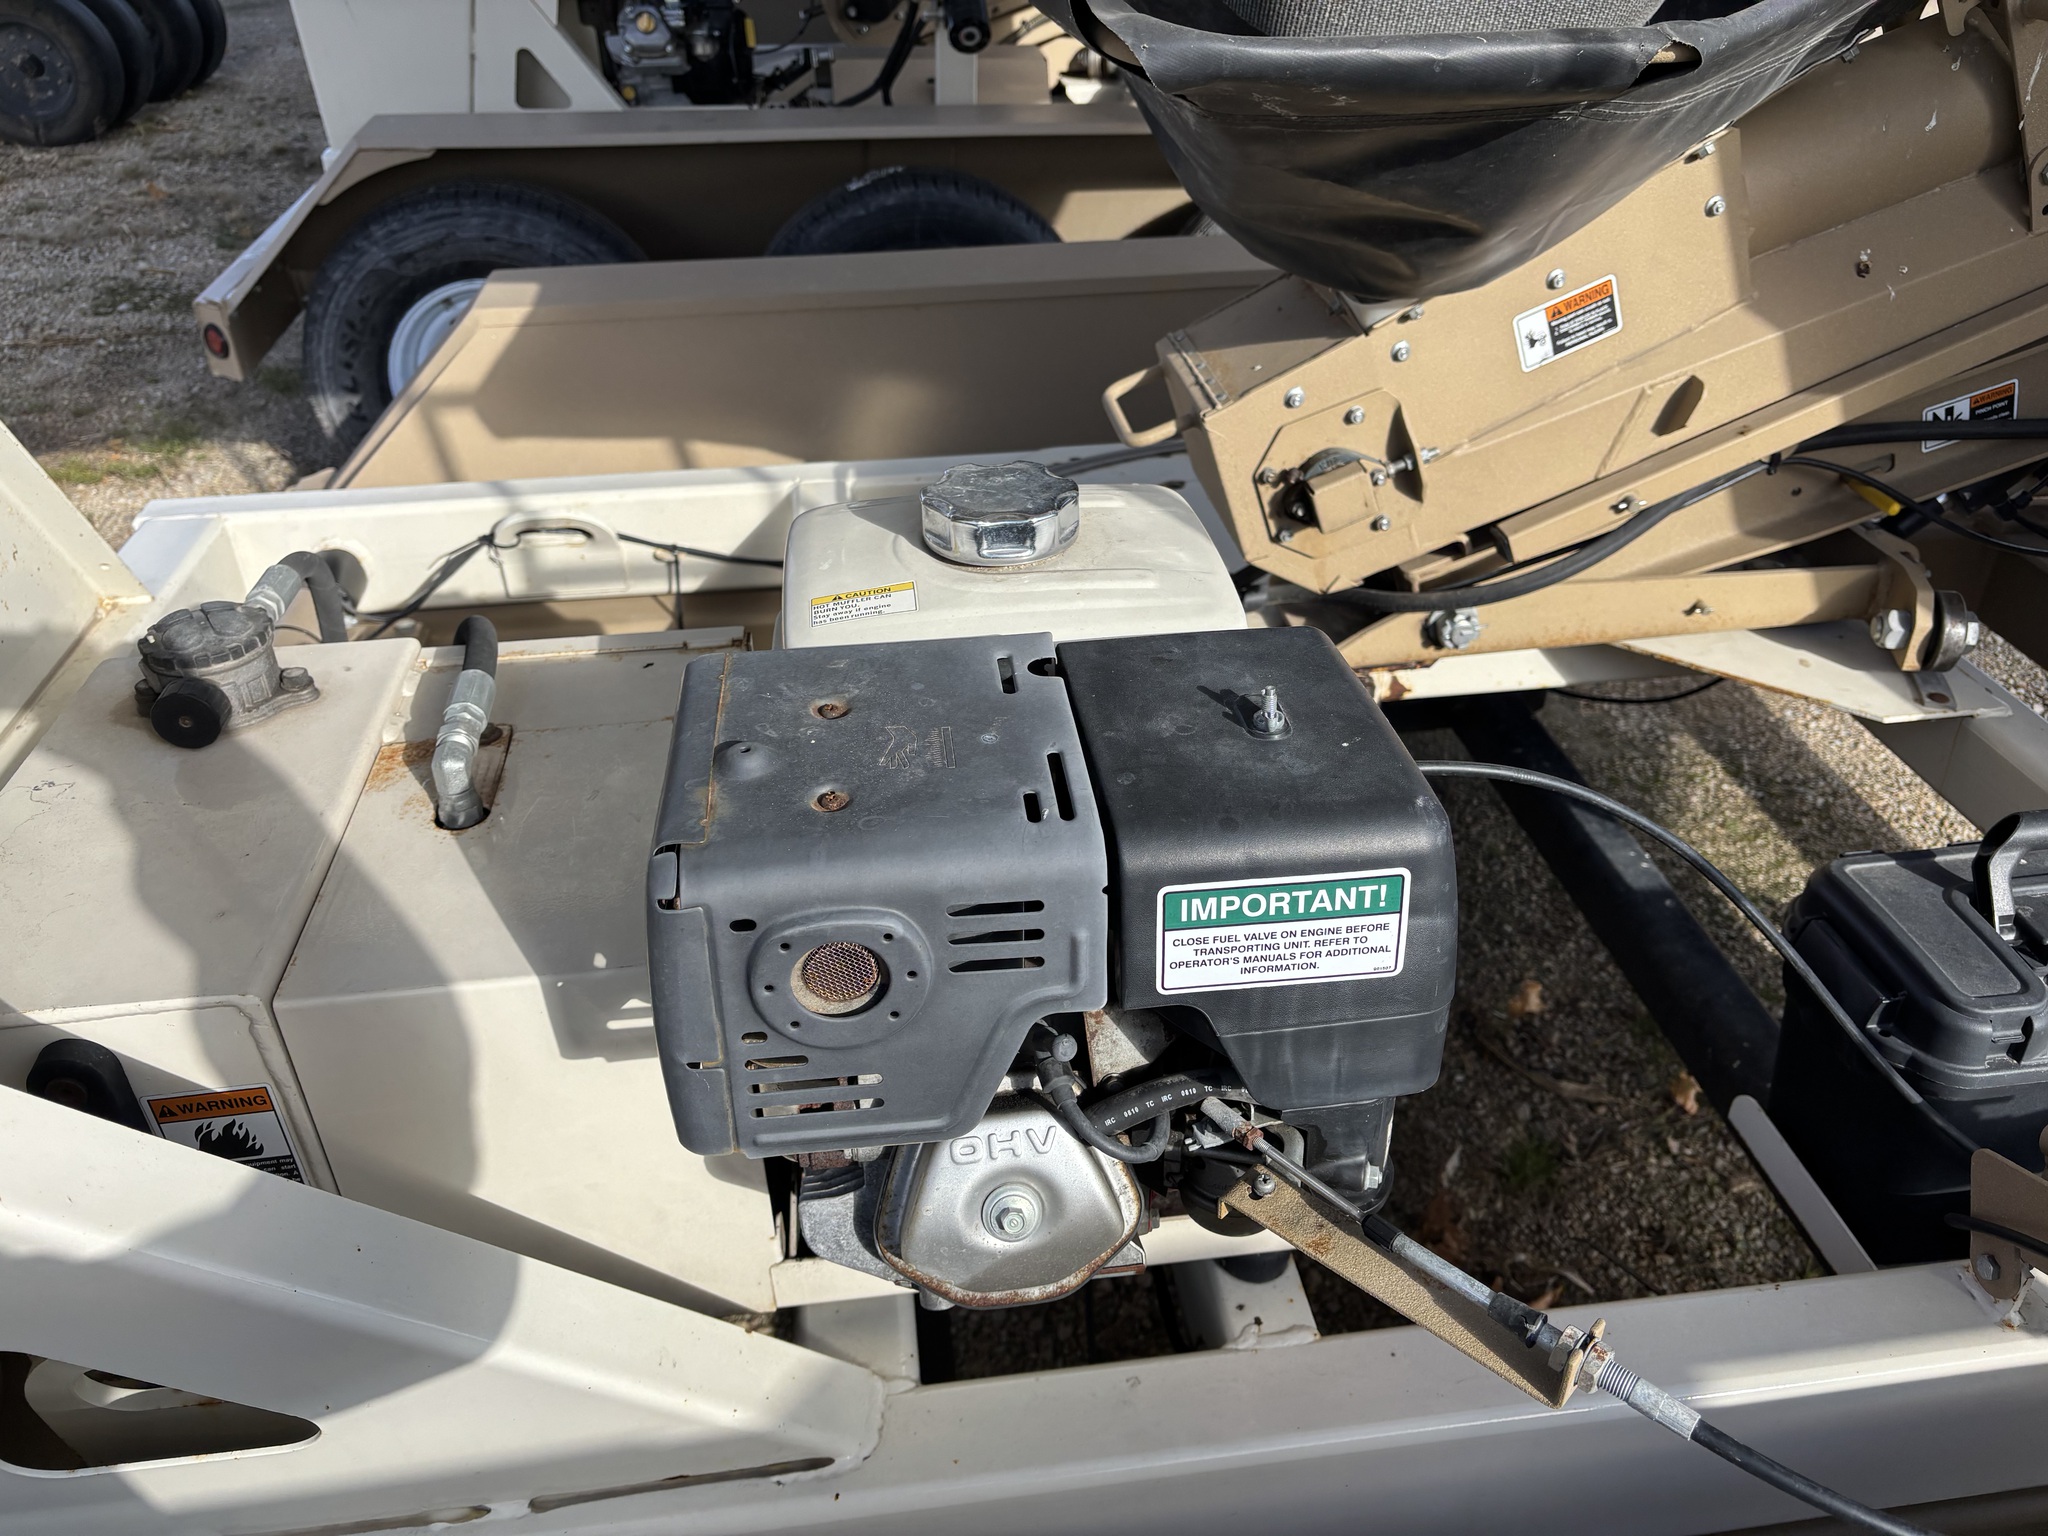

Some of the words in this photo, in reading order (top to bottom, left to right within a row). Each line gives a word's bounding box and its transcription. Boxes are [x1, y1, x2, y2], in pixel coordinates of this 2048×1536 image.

[1563, 284, 1609, 312] WARNING
[1979, 386, 2013, 404] WARNING
[1992, 400, 2009, 410] POINT
[813, 603, 829, 611] HOT
[833, 596, 871, 606] MUFFLER
[874, 593, 892, 601] CAN
[845, 587, 891, 598] CAUTION
[813, 607, 838, 615] BURN
[813, 613, 830, 621] Stay
[833, 609, 853, 617] away
[863, 603, 891, 612] engine
[1181, 884, 1387, 922] IMPORTANT!
[1172, 936, 1210, 947] CLOSE
[1213, 935, 1241, 944] FUEL
[1244, 931, 1278, 942] VALVE
[1280, 930, 1297, 939] ON
[1300, 926, 1343, 938] ENGINE
[1346, 923, 1390, 934] BEFORE
[1193, 942, 1281, 957] TRANSPORTING
[1283, 940, 1310, 950] UNIT.
[1314, 937, 1350, 948] REFER
[1353, 936, 1368, 944] TO
[1169, 957, 1240, 970] OPERATOR'S
[1243, 952, 1297, 964] MANUALS
[1299, 951, 1322, 960] FOR
[1325, 945, 1391, 958] ADDITIONAL
[1240, 962, 1319, 975] INFORMATION.
[176, 1095, 268, 1115] WARNING
[1104, 1116, 1116, 1127] IRC
[1123, 1106, 1140, 1118] 0810
[1145, 1100, 1155, 1108] TC
[1160, 1093, 1173, 1103] IRC
[1181, 1087, 1197, 1097] 0810
[1204, 1085, 1213, 1093] TC
[949, 1125, 1057, 1165] OHV
